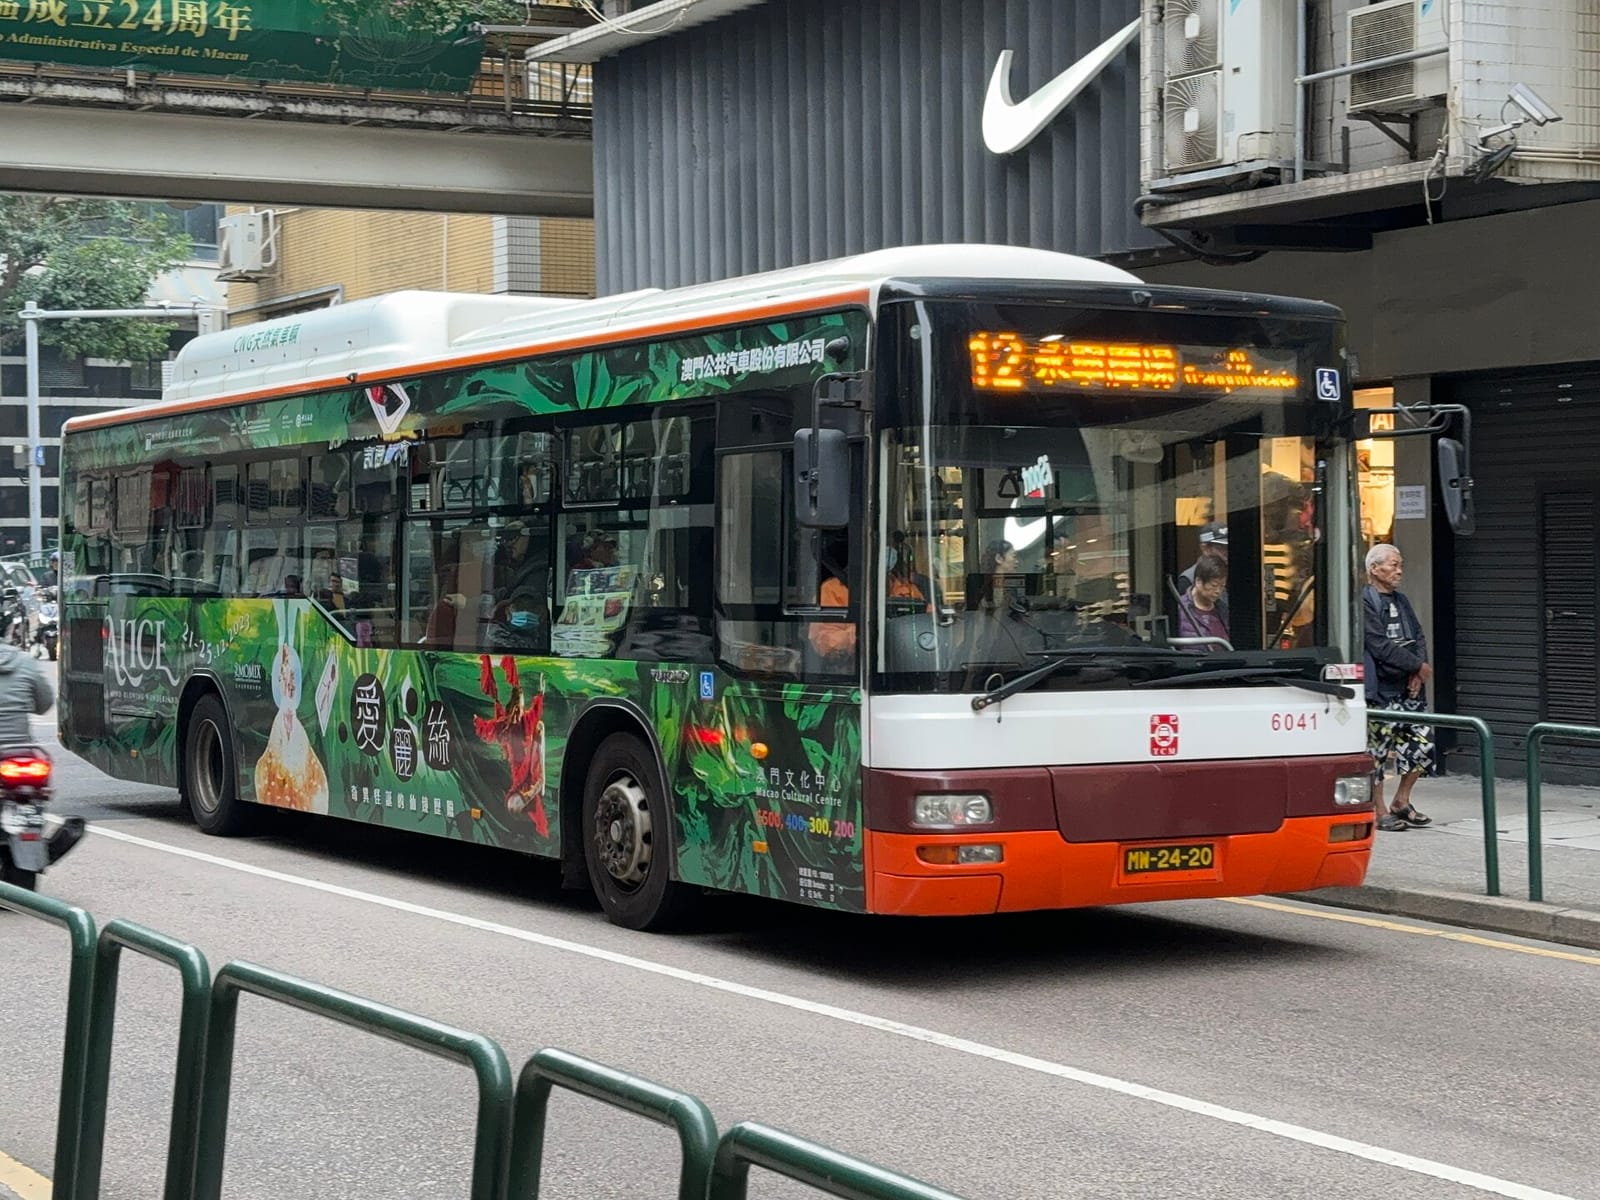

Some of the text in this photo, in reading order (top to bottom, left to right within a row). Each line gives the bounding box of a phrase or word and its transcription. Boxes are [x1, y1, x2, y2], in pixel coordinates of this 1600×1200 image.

[6, 33, 117, 51] Administrativa
[120, 42, 179, 55] Especial
[181, 46, 199, 57] de
[202, 48, 249, 61] Macau
[681, 338, 826, 381] 澳門公共汽車股份有限公司
[1271, 713, 1318, 731] 6041
[1153, 747, 1176, 755] TCM
[756, 787, 842, 807] Macao Cultural Centre
[809, 816, 832, 838] 300,
[833, 820, 855, 838] 200
